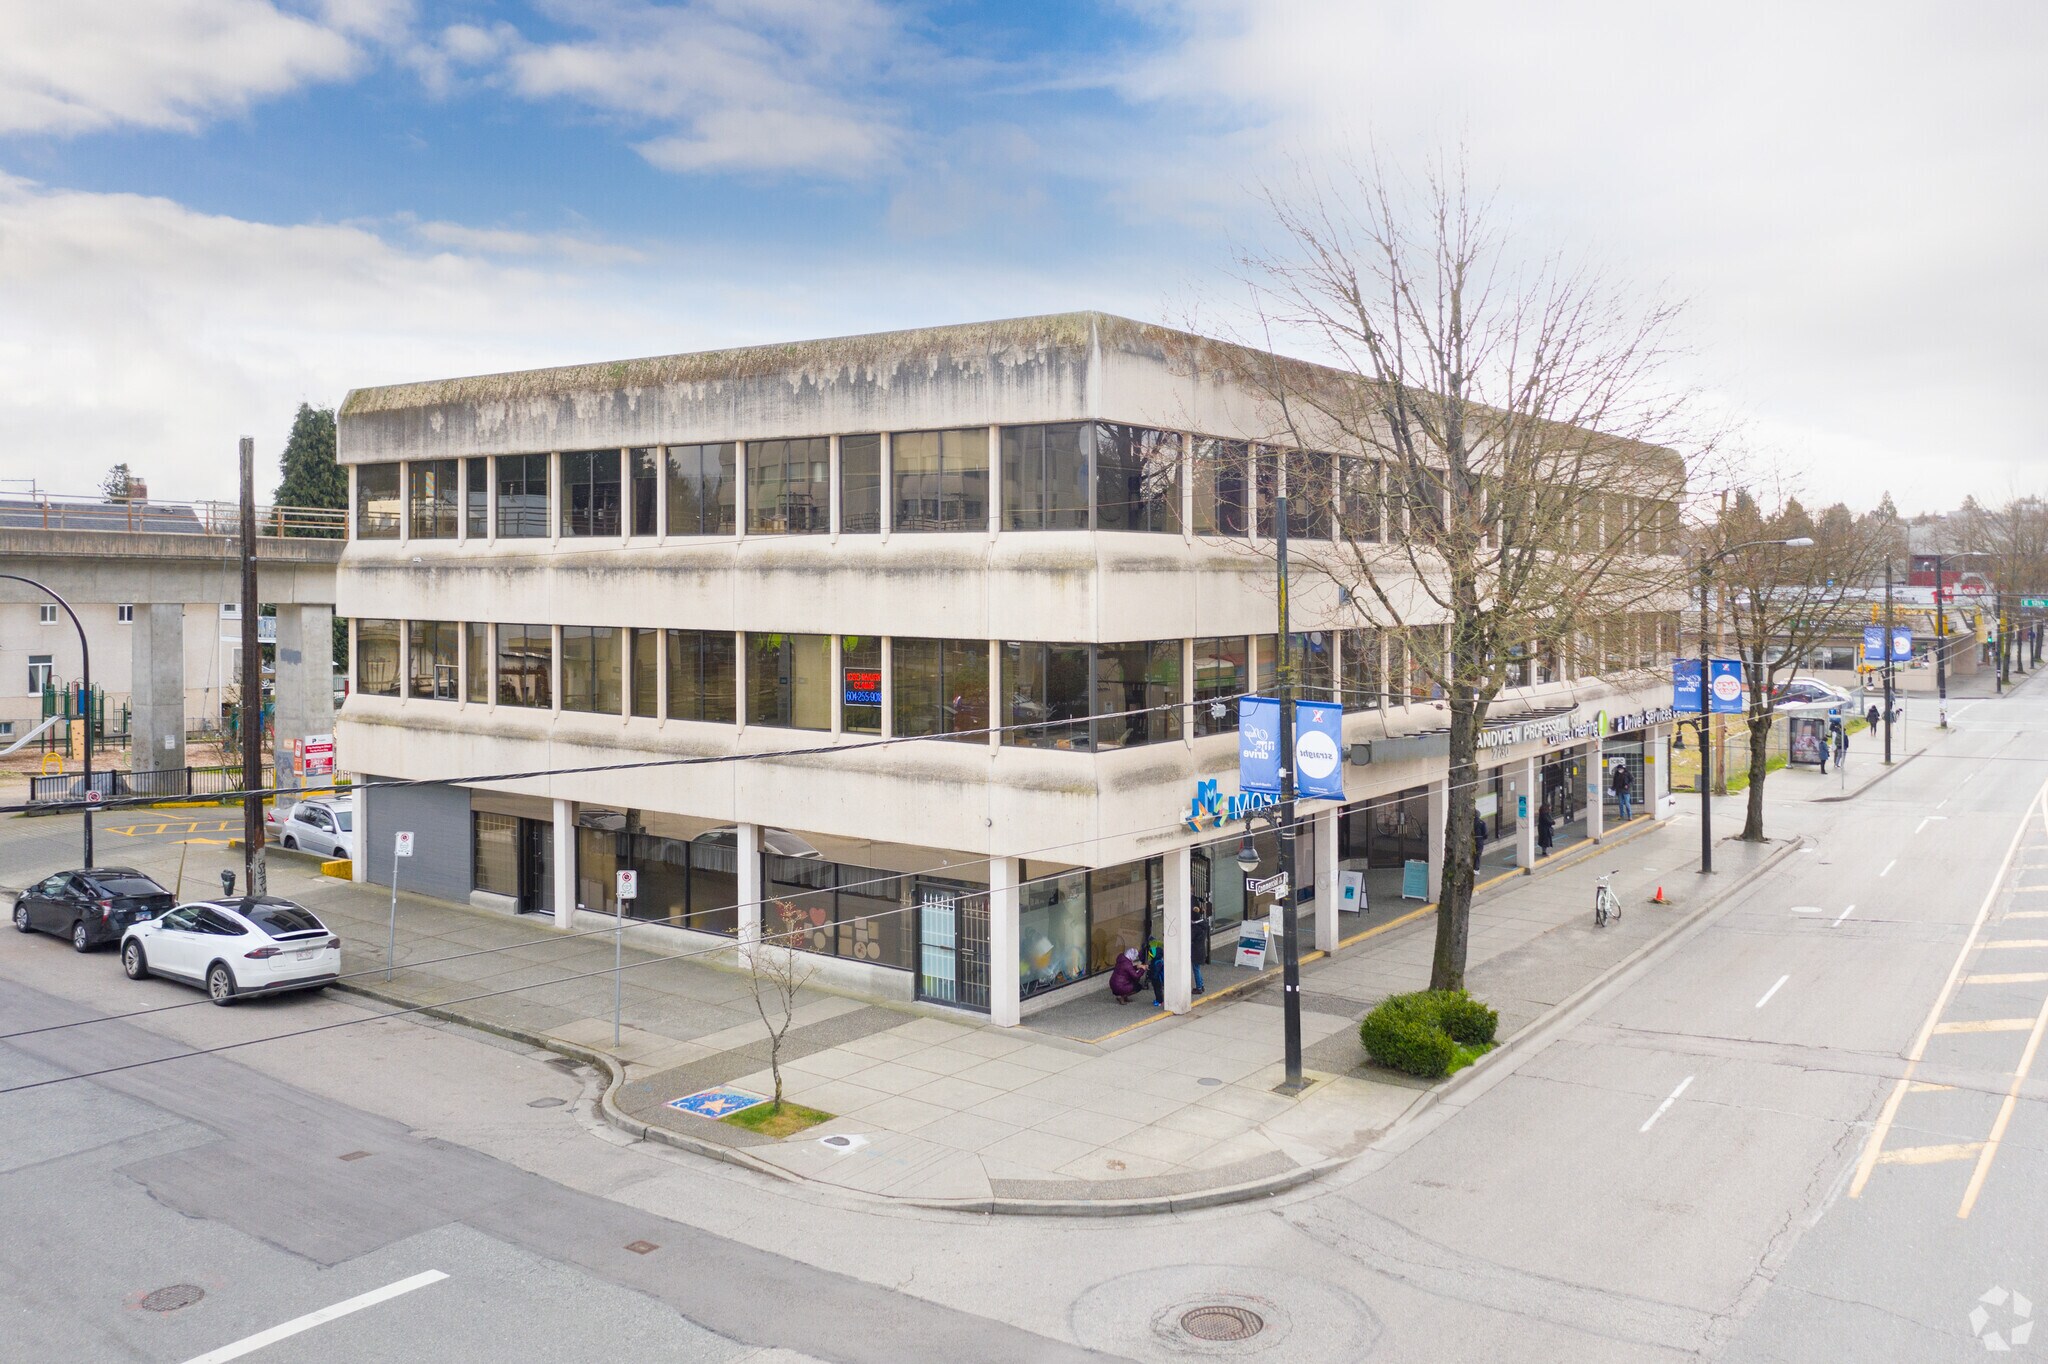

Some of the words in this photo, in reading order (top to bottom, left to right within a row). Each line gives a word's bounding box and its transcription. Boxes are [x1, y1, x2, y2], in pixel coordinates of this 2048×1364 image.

[1623, 713, 1645, 730] Driver
[1644, 708, 1673, 725] Services
[1477, 726, 1522, 749] ANDVIEW
[1250, 881, 1255, 889] E
[1257, 878, 1279, 893] Commercial
